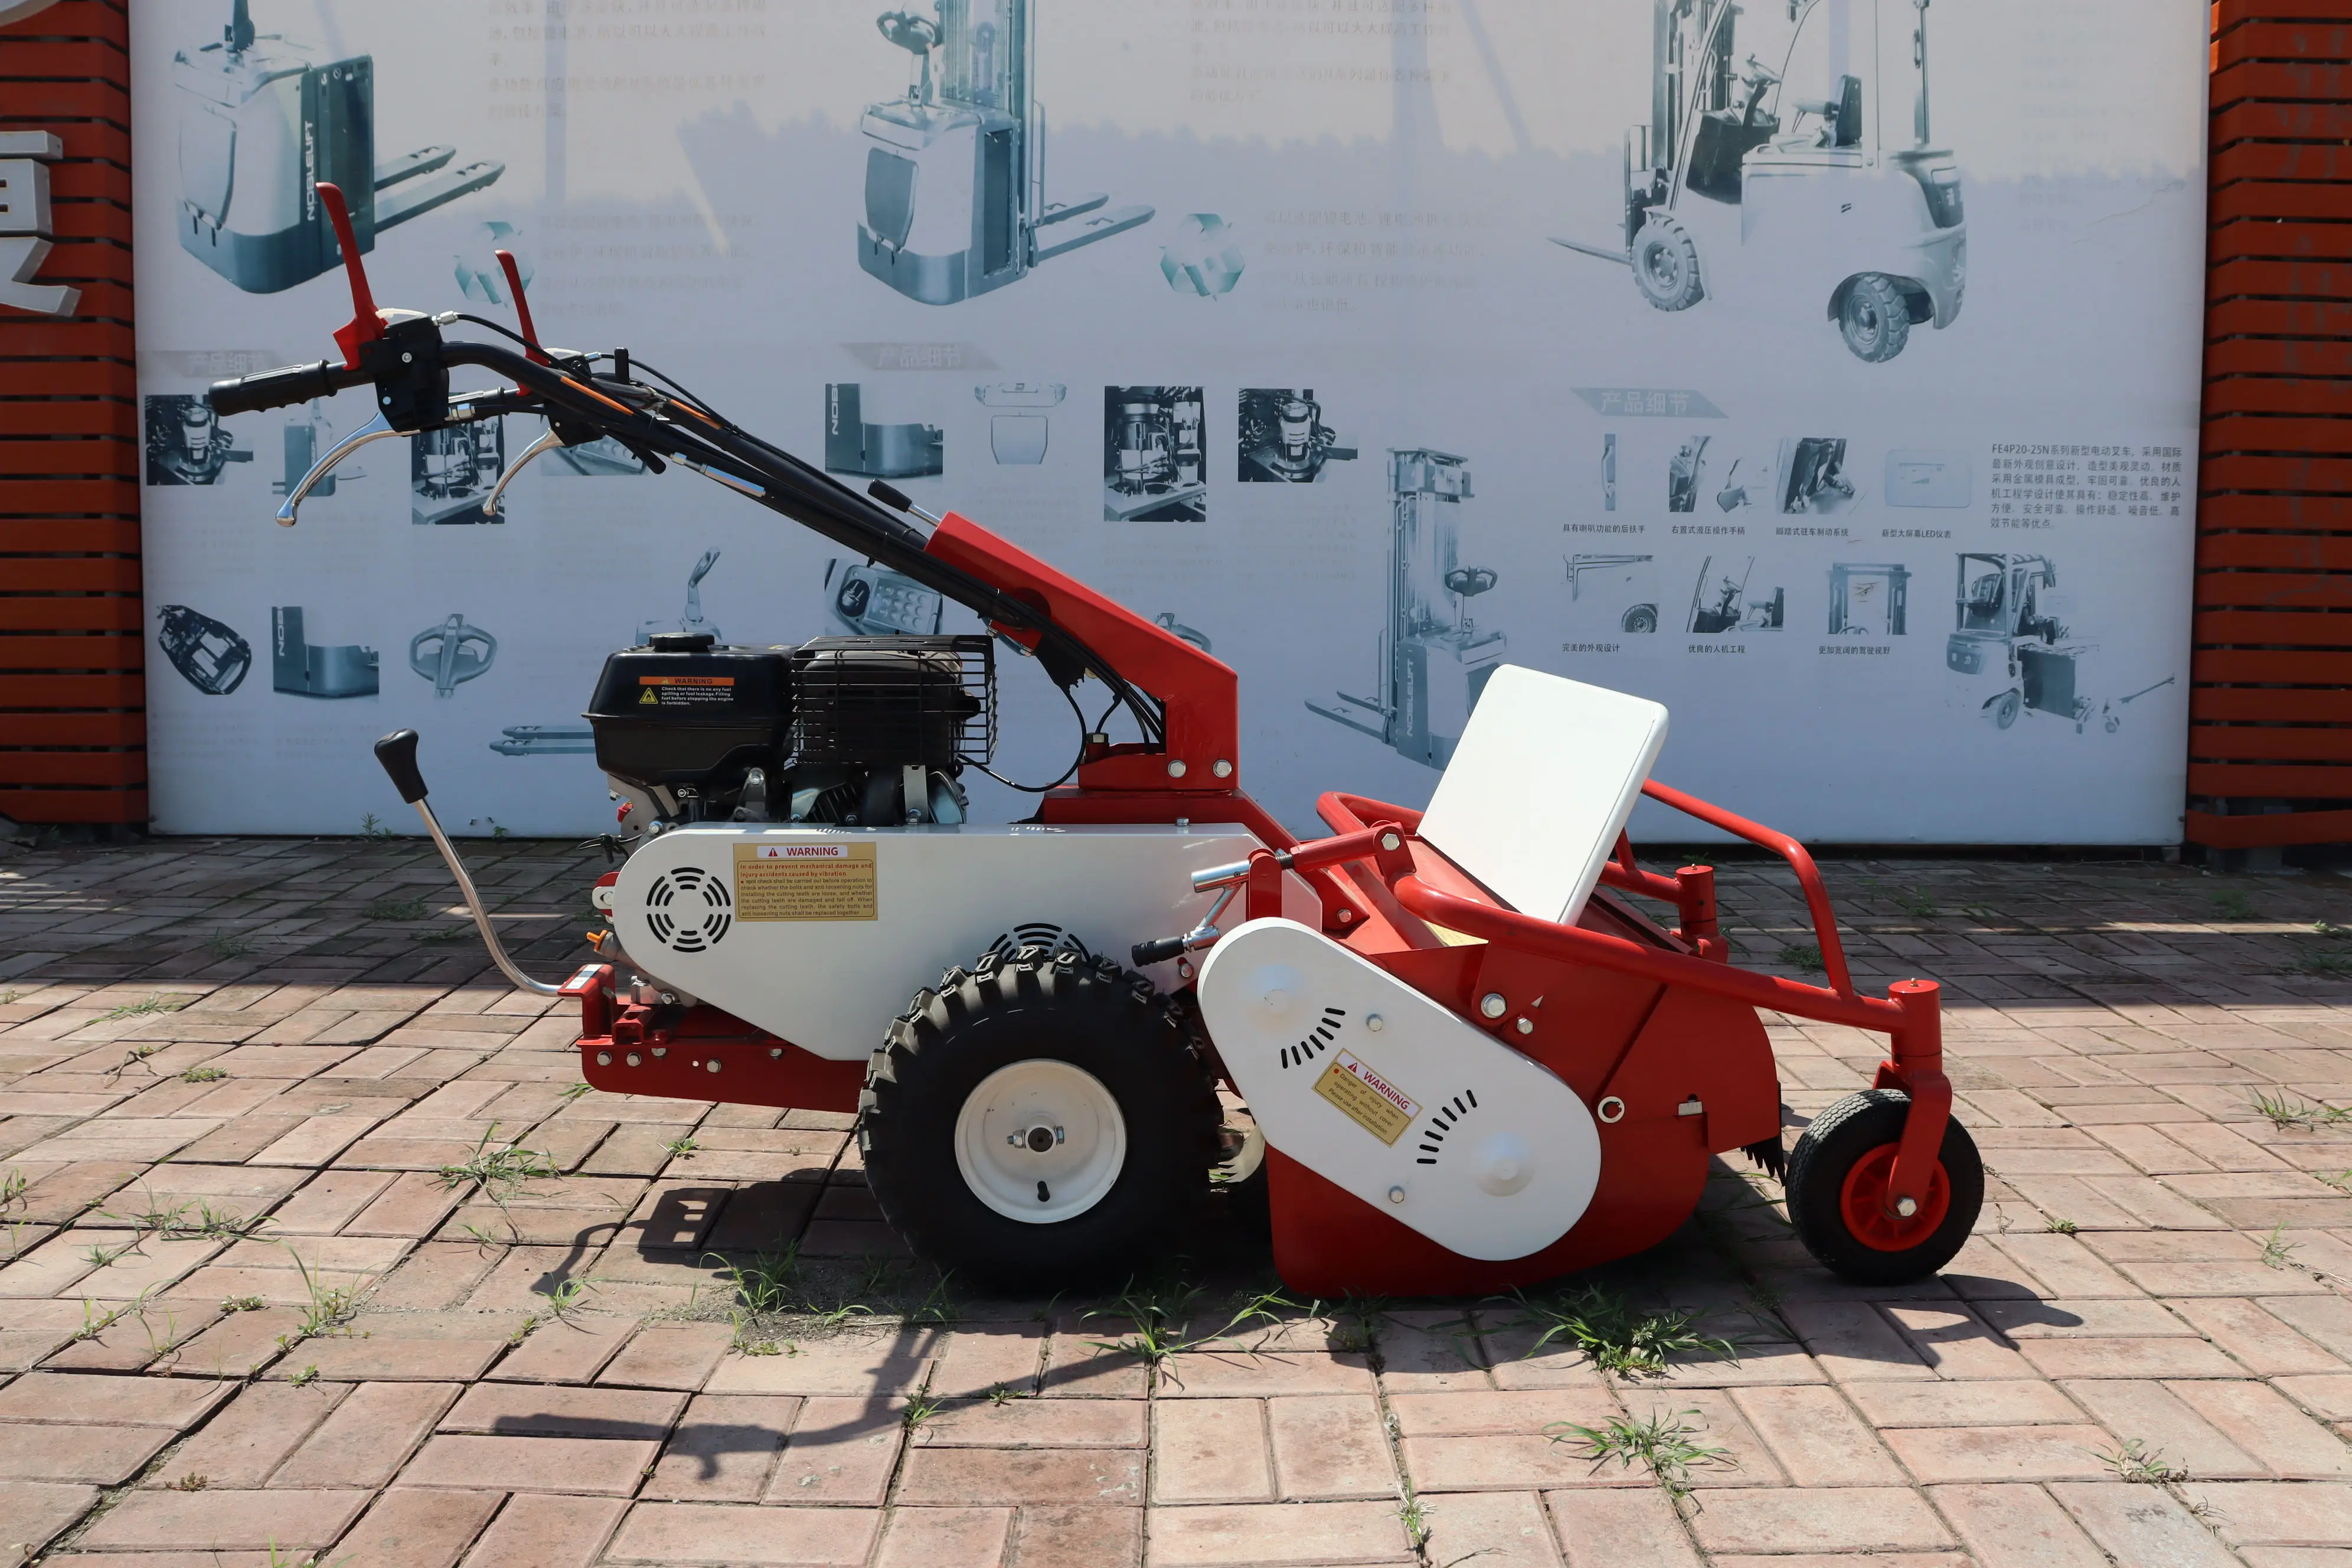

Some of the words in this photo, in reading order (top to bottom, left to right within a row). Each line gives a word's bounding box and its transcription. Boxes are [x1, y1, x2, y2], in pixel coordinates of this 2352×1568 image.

[305, 120, 315, 221] NOBLELIFT
[878, 345, 962, 368] 产品细节
[1601, 390, 1690, 415] 产品细节
[1562, 643, 1621, 652] 完美的外观设计
[1688, 644, 1746, 654] 优良的人机工程
[1818, 645, 1891, 655] 更加宽阔的驾驶视野
[1406, 658, 1414, 737] NOBLELIFT
[786, 847, 838, 856] WARNING
[1334, 1082, 1357, 1102] operating
[1359, 1100, 1378, 1116] without
[1379, 1115, 1393, 1127] cover
[1340, 1073, 1357, 1089] Danger
[1369, 1096, 1383, 1108] injury
[1386, 1108, 1399, 1120] when
[1364, 1071, 1410, 1110] WARNING
[1328, 1087, 1344, 1102] Please
[1343, 1099, 1352, 1108] use
[1351, 1106, 1363, 1116] after
[1363, 1113, 1388, 1135] installation
